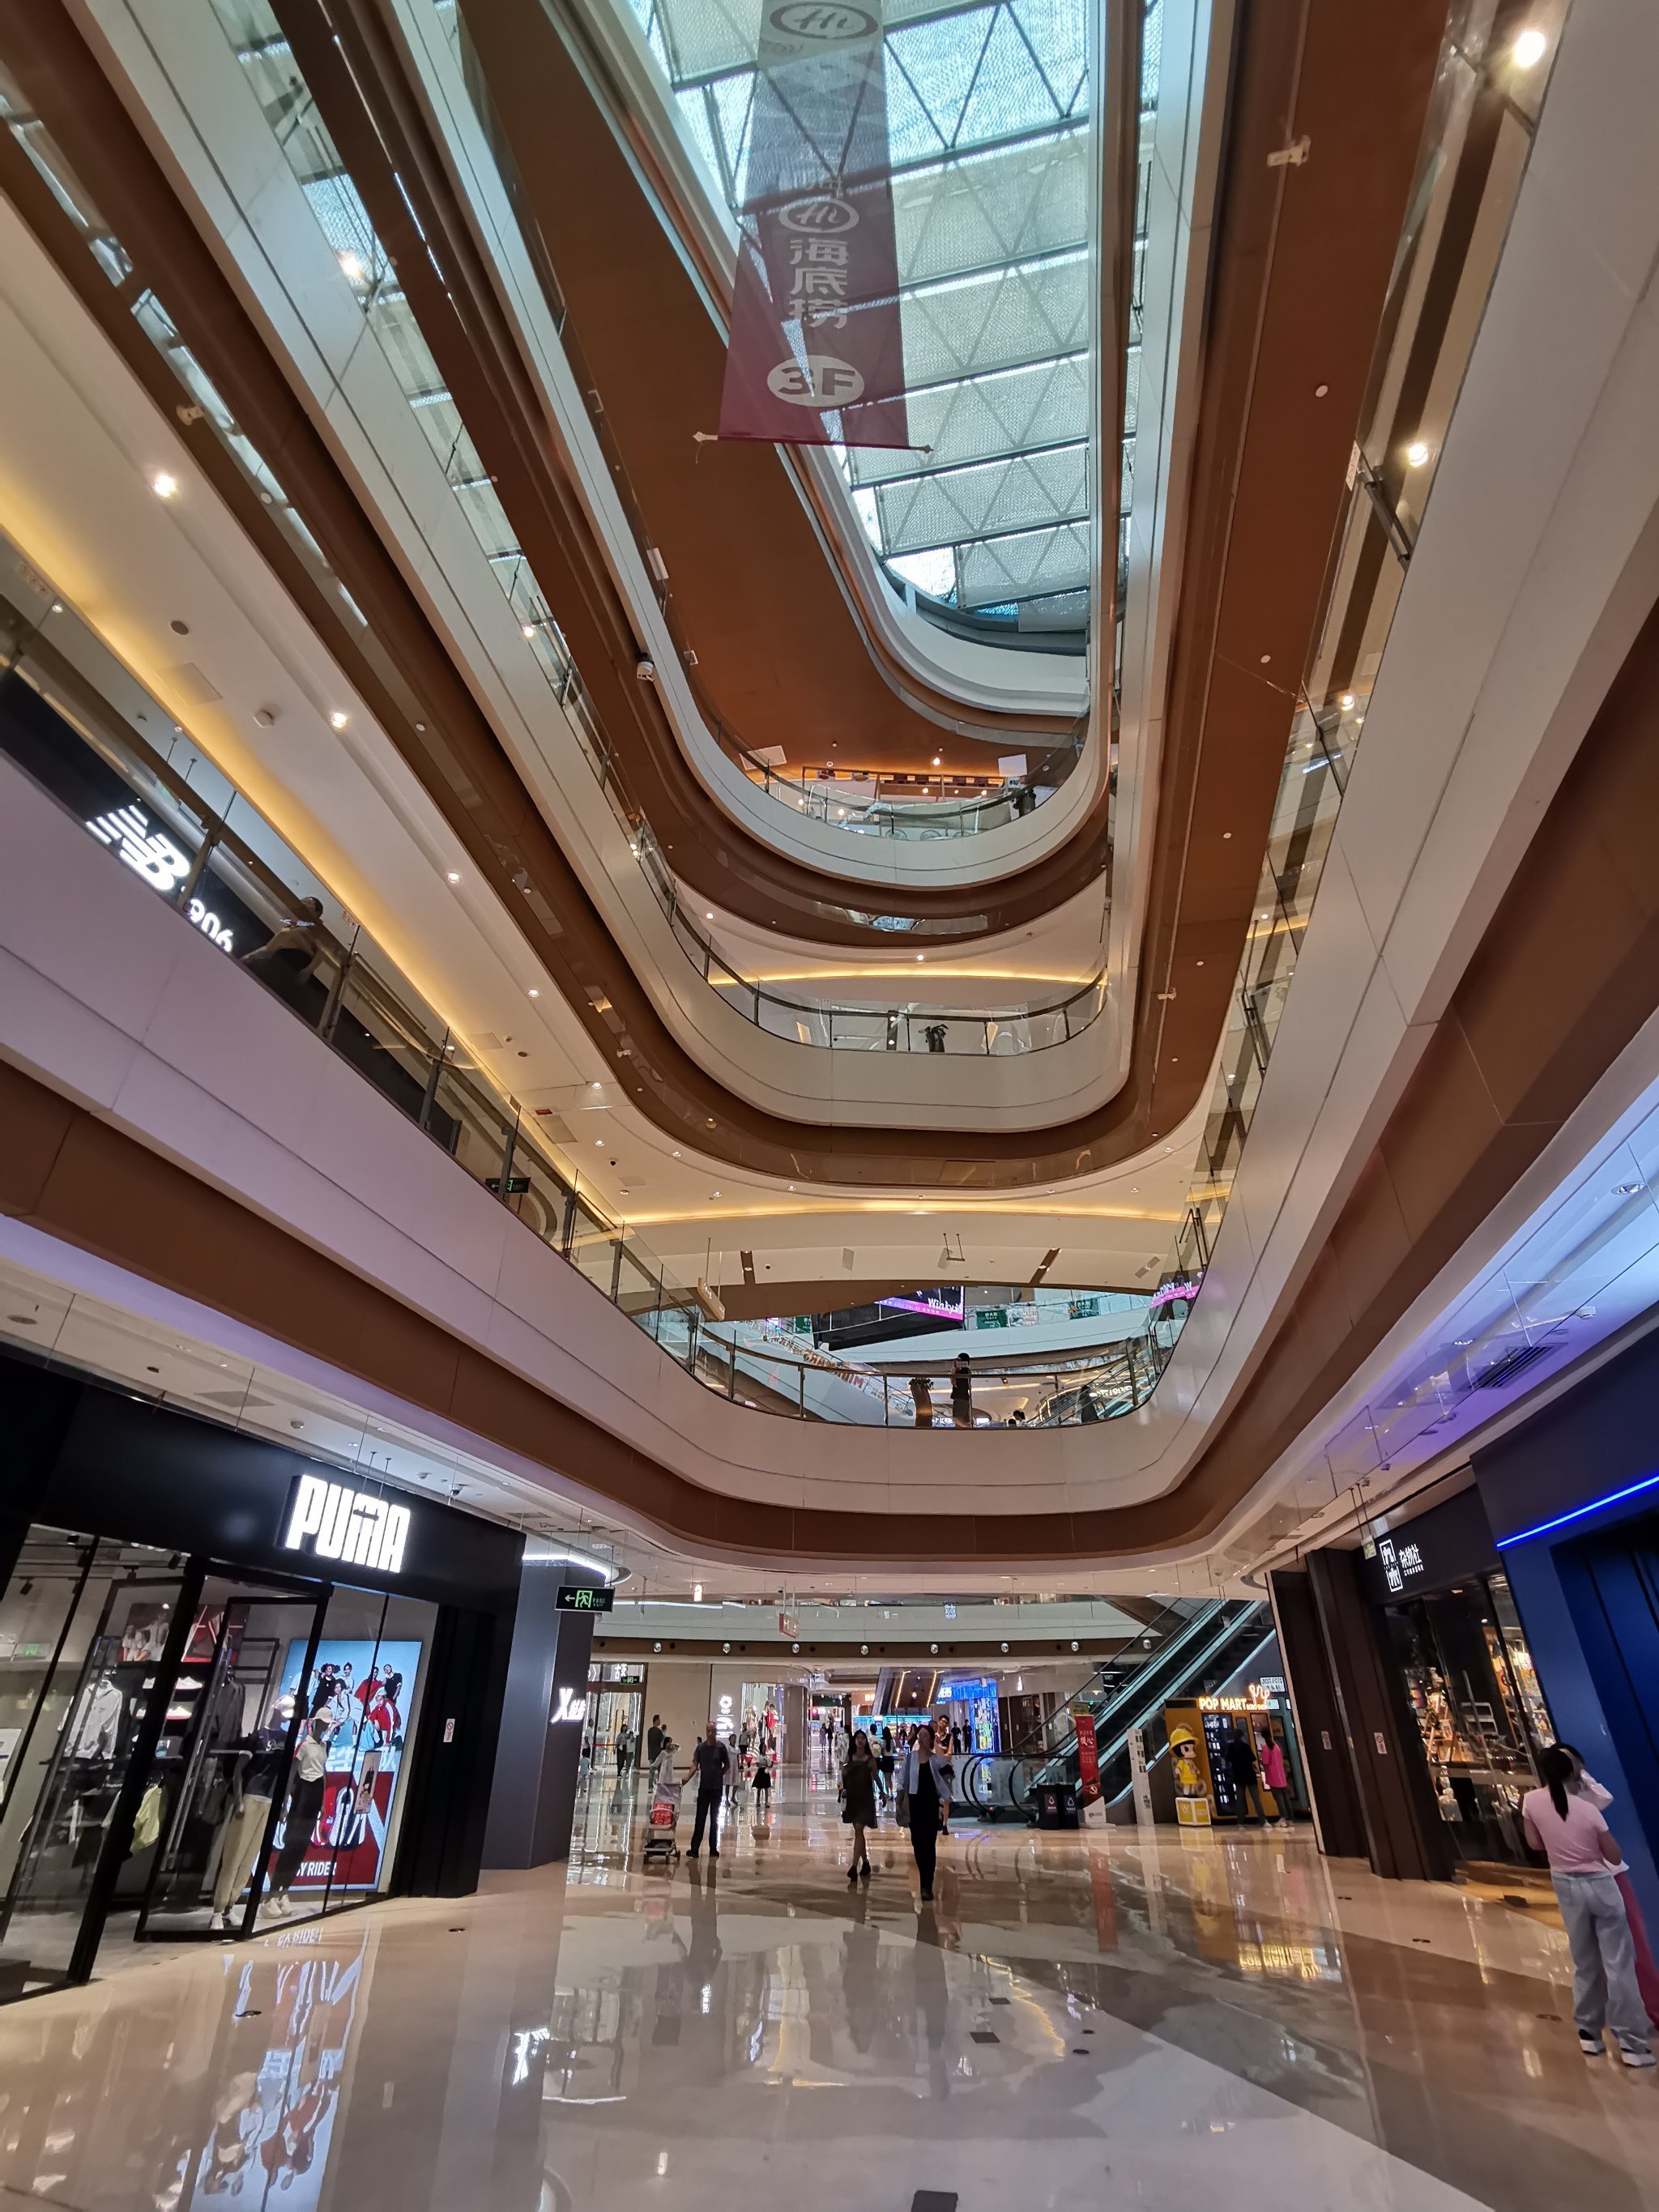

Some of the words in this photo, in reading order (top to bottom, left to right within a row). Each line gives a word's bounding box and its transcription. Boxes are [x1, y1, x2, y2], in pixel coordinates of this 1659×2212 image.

[789, 238, 849, 329] 海底捞
[778, 367, 855, 396] 3F
[285, 1474, 411, 1574] PUMA
[1399, 1543, 1422, 1569] 杂物社
[1199, 1698, 1219, 1710] POP
[1221, 1698, 1247, 1710] MART
